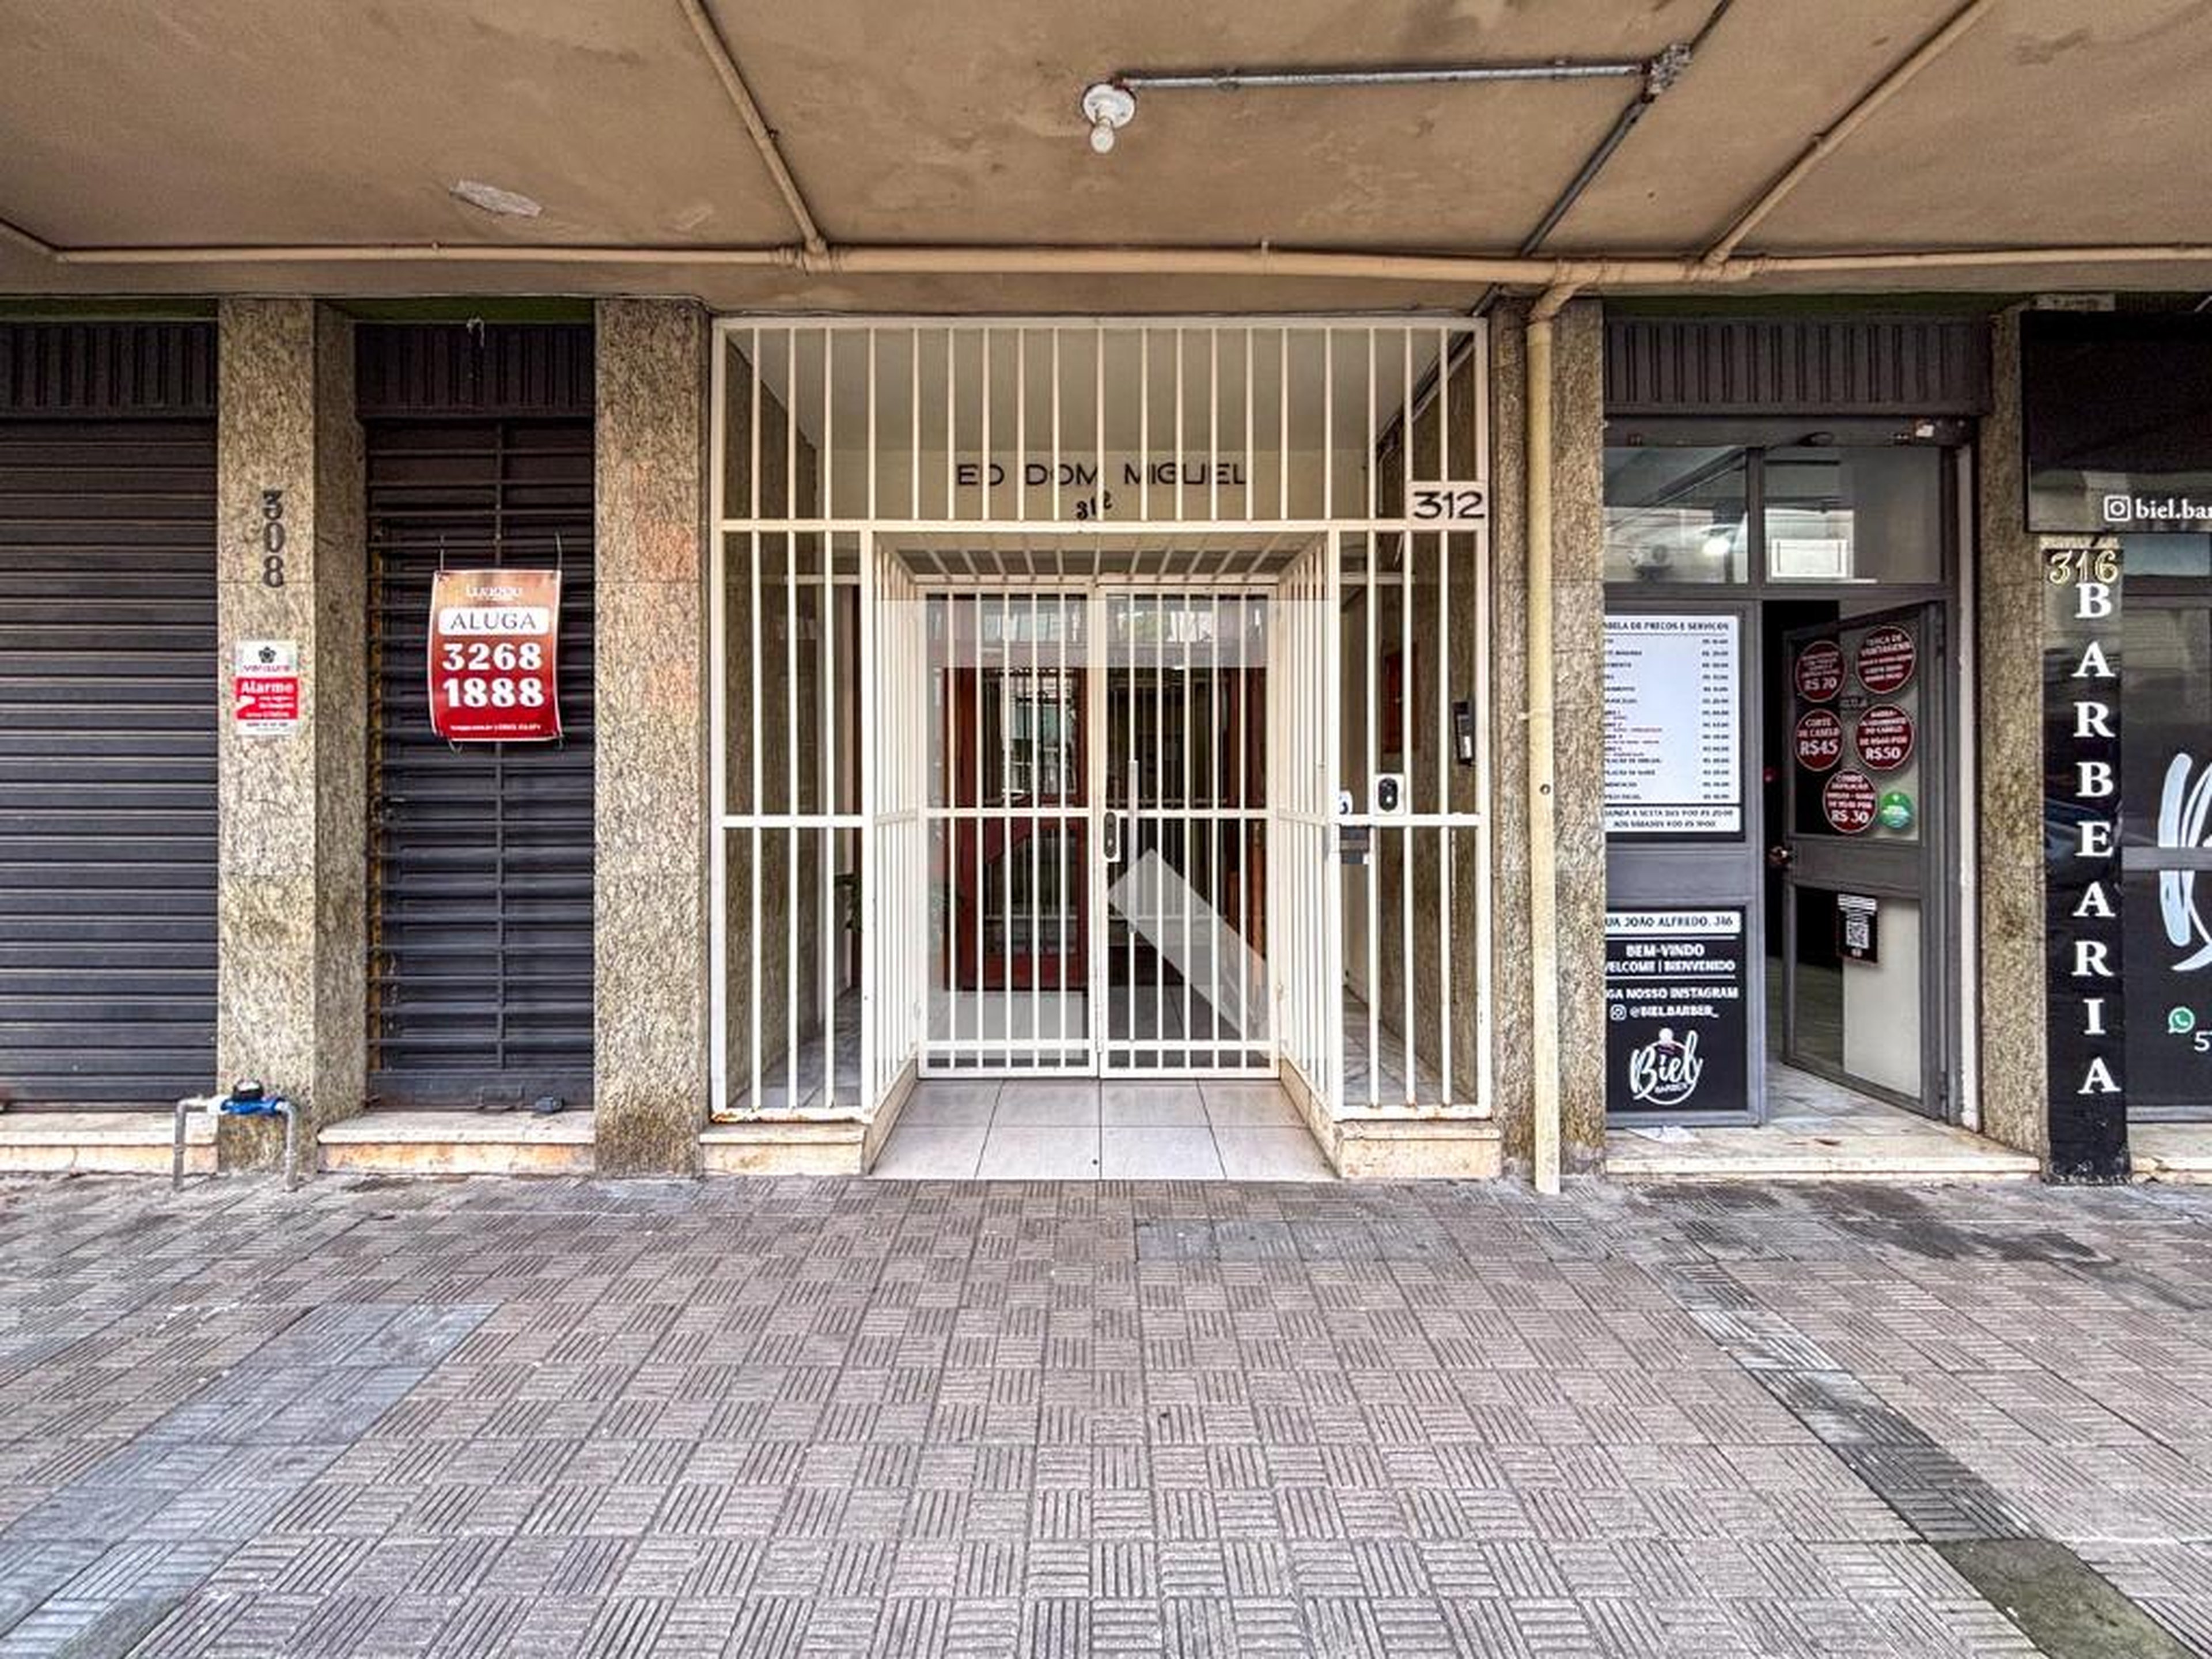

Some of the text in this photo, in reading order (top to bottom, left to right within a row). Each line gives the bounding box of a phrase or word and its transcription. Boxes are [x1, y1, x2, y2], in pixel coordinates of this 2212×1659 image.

[957, 462, 1247, 486] ED DOM MIGUEL
[1413, 490, 1485, 520] 312
[262, 490, 285, 588] 308
[2049, 550, 2119, 585] 316
[450, 612, 536, 630] ALUGA
[442, 642, 542, 671] 3268
[241, 680, 294, 693] Alarme
[442, 677, 544, 707] 1888
[2073, 583, 2121, 1094] BARBEARIA
[1604, 916, 1621, 927] UA
[1626, 942, 1705, 957] BEM-VINDO
[1606, 986, 1739, 1000] GA NOSSO INSTAGRAM
[2193, 1030, 2212, 1052] 5
